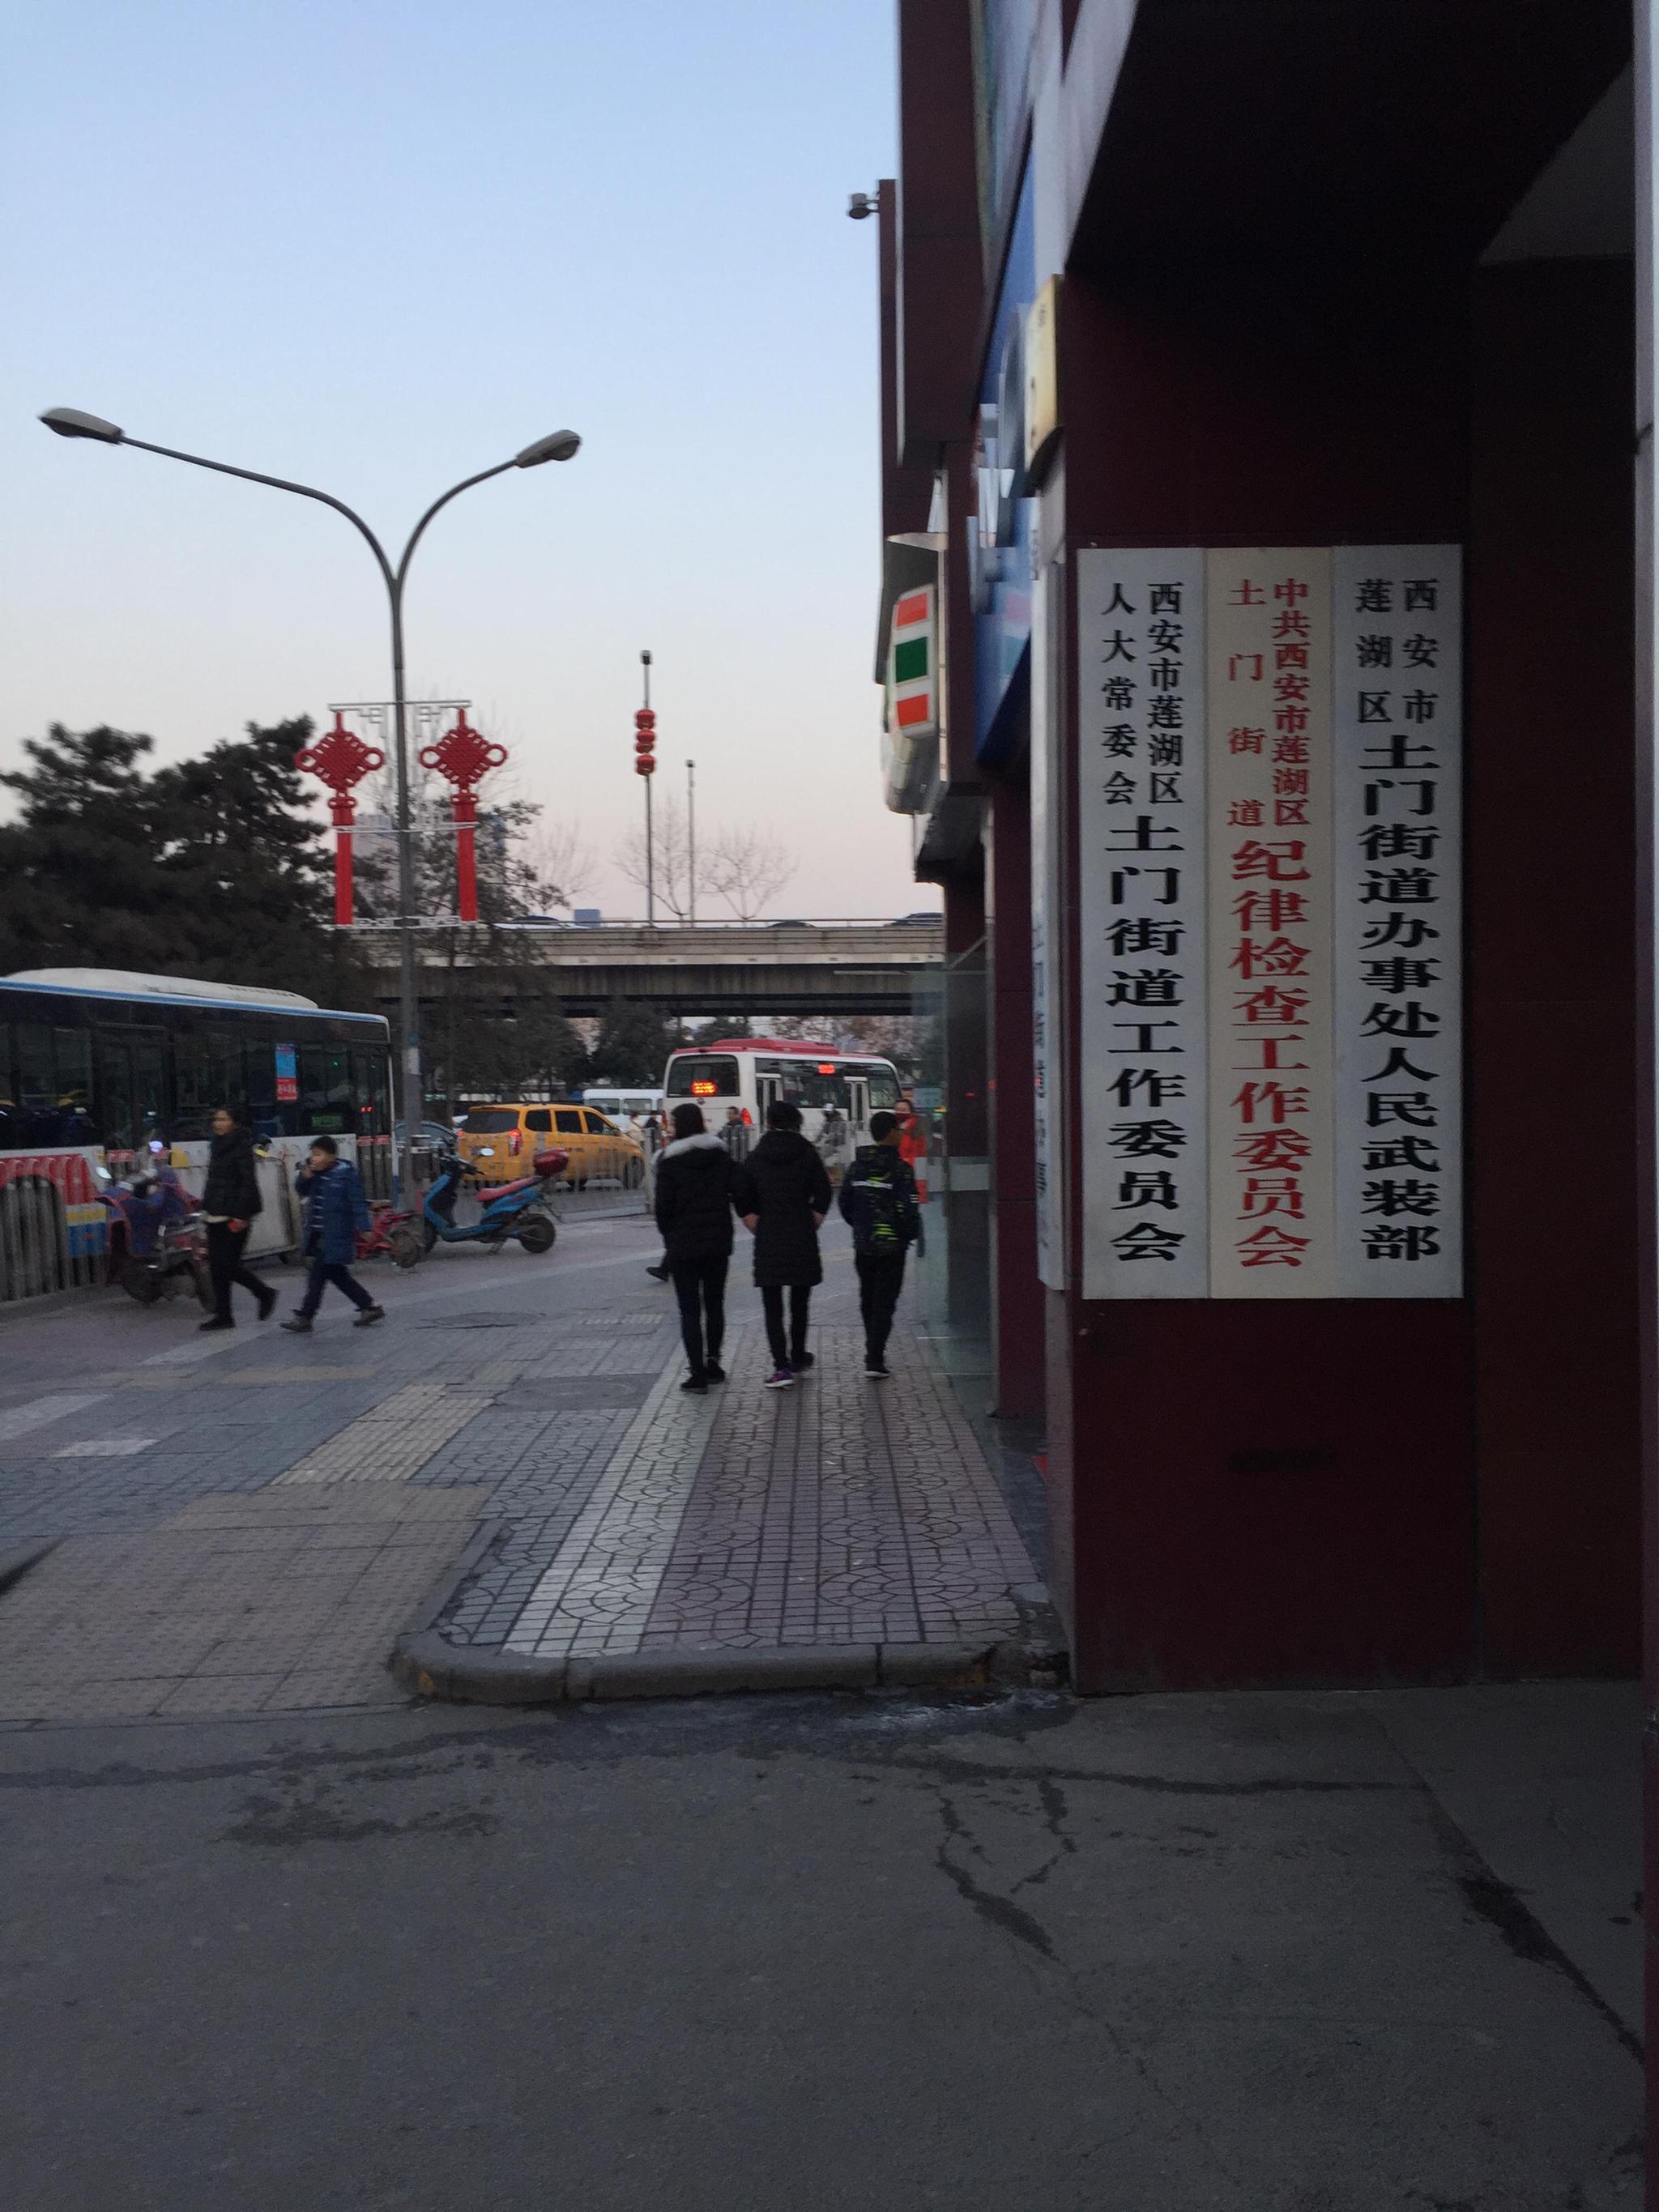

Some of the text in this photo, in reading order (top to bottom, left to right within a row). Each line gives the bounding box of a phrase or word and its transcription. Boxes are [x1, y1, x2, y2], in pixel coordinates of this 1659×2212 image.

[1102, 583, 1137, 804] 人大常委会
[1147, 582, 1183, 804] 西安市莲湖区
[1227, 580, 1265, 827] 土门街道
[1271, 578, 1309, 827] 中共西安市莲湖区
[1356, 579, 1392, 722] 莲湖区
[1402, 579, 1438, 724] 西安市
[1104, 816, 1188, 1261] 土门街道工作委员会
[1228, 840, 1312, 1268] 纪律检查工作委员会
[1357, 735, 1442, 1261] 土门街道办事处人民武装部
